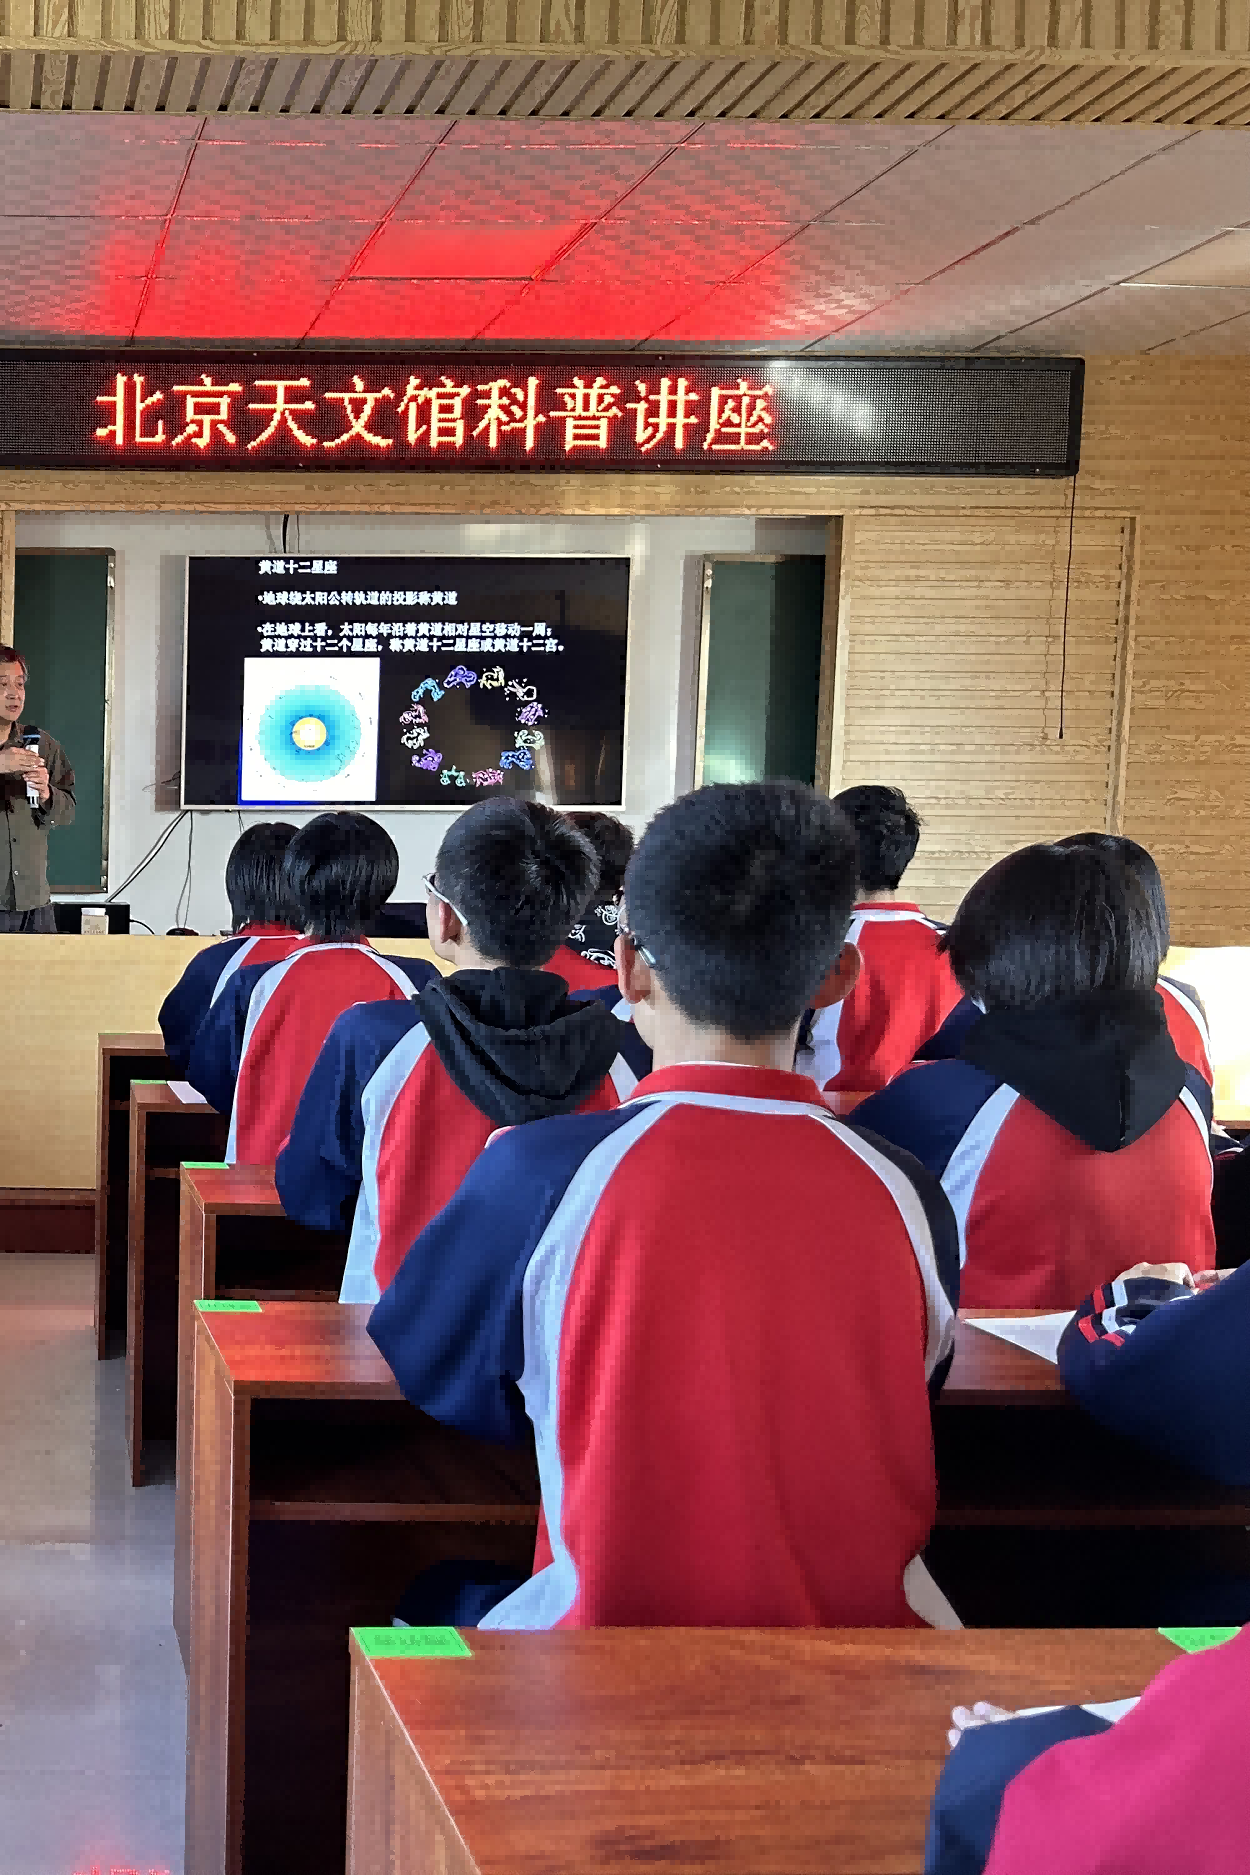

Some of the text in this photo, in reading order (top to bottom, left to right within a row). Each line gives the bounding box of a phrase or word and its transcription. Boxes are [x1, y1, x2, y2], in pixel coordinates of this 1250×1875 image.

[95, 373, 773, 451] 北京天文馆科普讲座
[259, 560, 338, 574] 黄道十二星座
